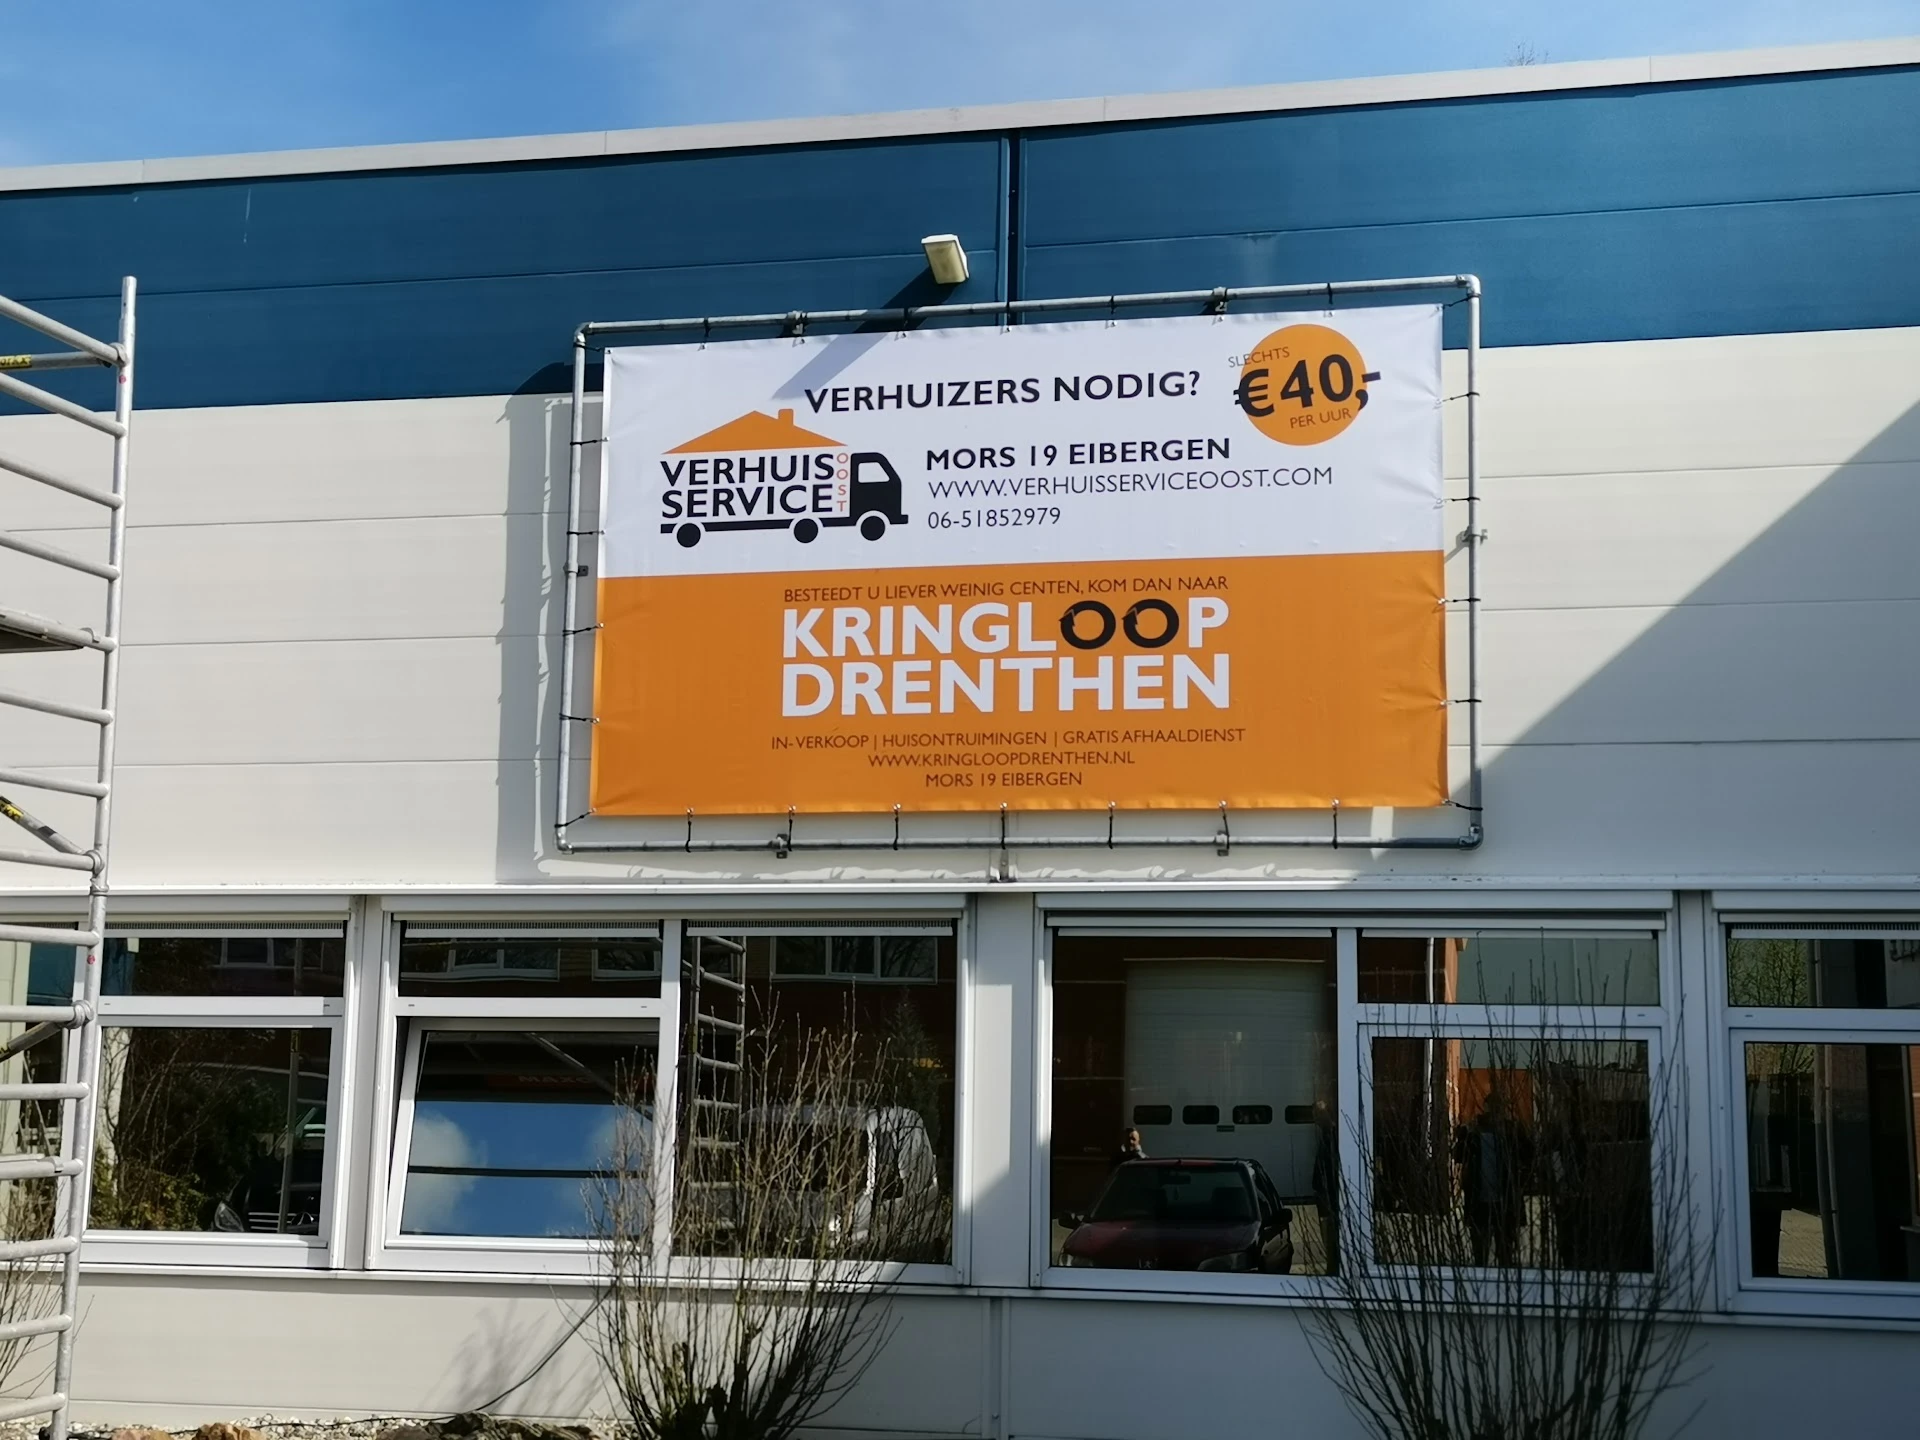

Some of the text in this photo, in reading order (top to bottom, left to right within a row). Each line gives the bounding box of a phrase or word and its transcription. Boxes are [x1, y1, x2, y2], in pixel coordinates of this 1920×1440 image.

[1228, 346, 1290, 368] SLECHTS
[804, 370, 1201, 413] VERHUIZERS NODIG?
[1289, 407, 1352, 429] PER UUR
[926, 437, 1231, 471] MORS 19 EIBERGEN
[660, 452, 835, 487] VERHUIS
[928, 467, 1333, 499] WWW.VERHUISSERVICEOOST.COM
[661, 483, 833, 518] SERVICE
[928, 507, 1061, 529] 06-51852979
[784, 576, 1229, 602] BESTEEDT U LIEVER WEINIG CENTEN, KOM DAN NAAR
[783, 596, 1229, 659] KRINGLOOP
[782, 653, 1230, 717] DRENTHEN
[883, 731, 1047, 748] HUISONTRUIMINGEN
[1063, 730, 1119, 744] GRATIS
[1121, 728, 1247, 744] AFHAALDIENST
[868, 751, 1135, 768] WWW.KRINGLOOPDRENTHEN.NL
[926, 771, 1082, 788] MORS 19 EIBERGEN
